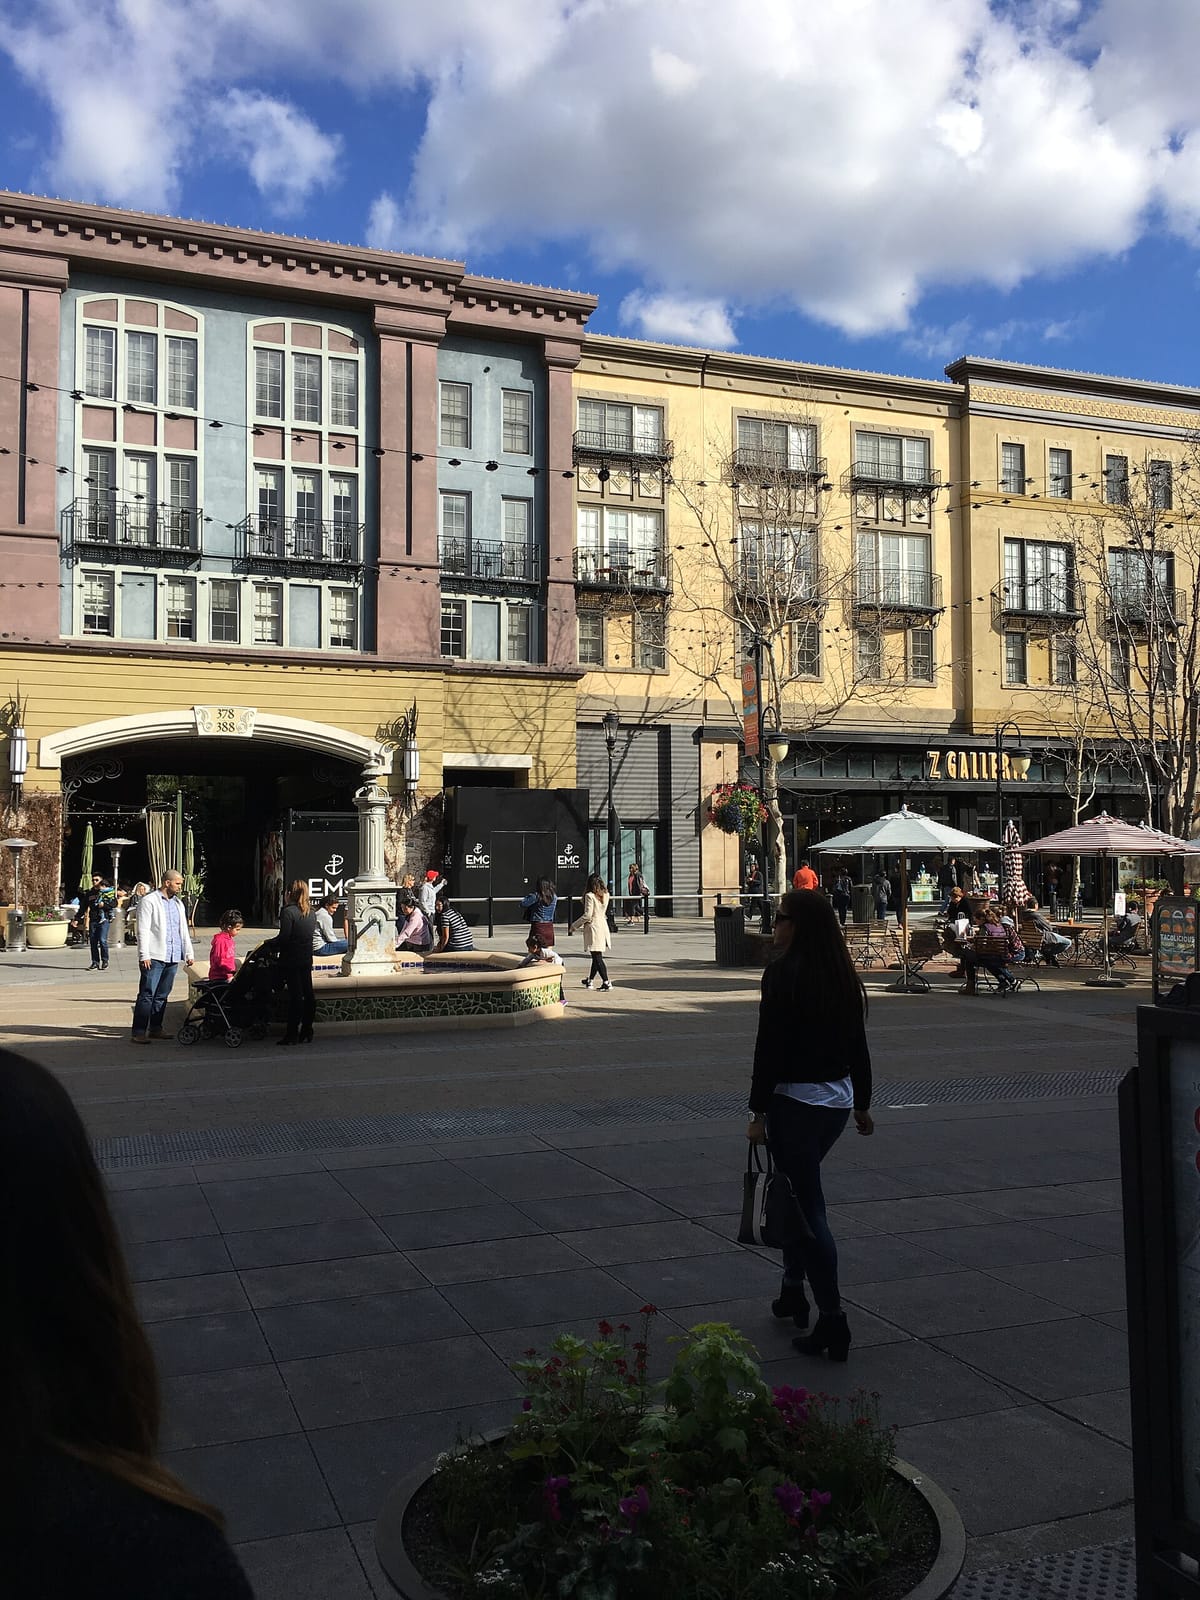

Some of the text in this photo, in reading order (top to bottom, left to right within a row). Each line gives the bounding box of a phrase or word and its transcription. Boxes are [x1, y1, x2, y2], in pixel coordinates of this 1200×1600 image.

[217, 708, 235, 719] 378
[217, 721, 235, 732] 388
[926, 750, 1028, 781] Z GALLER
[465, 854, 490, 865] EMC
[557, 855, 580, 865] EMC
[1160, 933, 1195, 943] TACOLICIOUS
